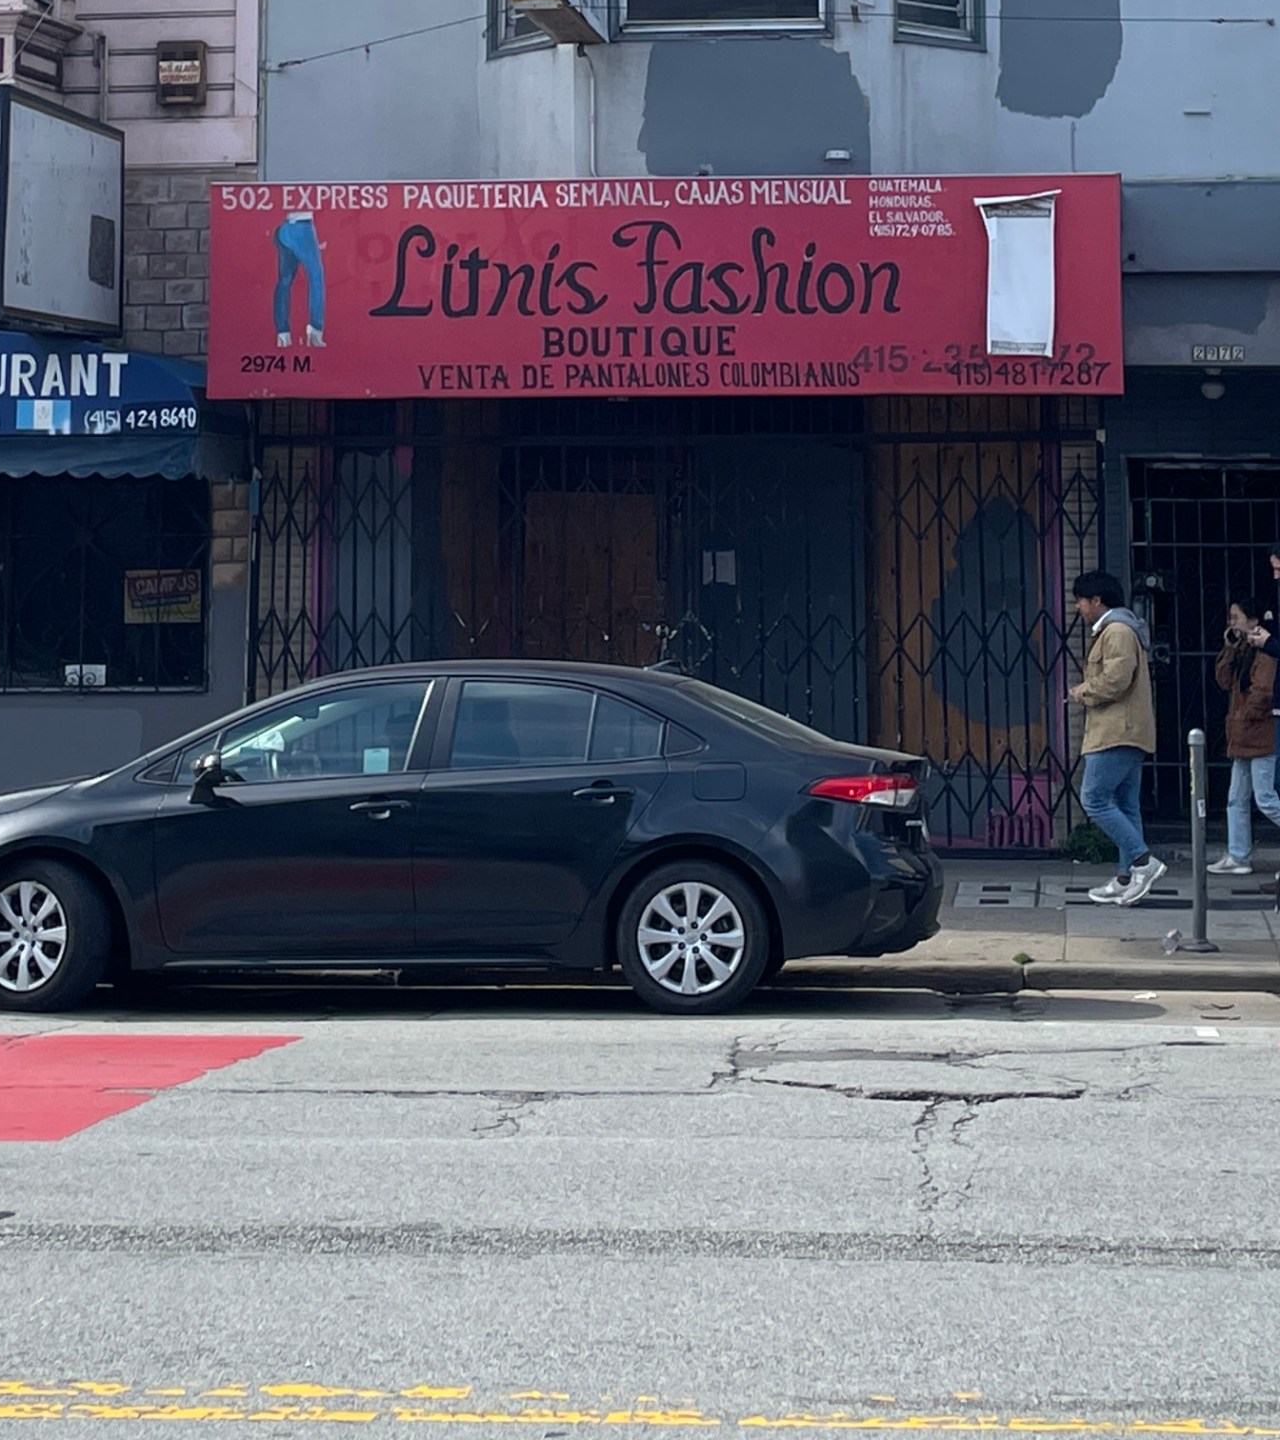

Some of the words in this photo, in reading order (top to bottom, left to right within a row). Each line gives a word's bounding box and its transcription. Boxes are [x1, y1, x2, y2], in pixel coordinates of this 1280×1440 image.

[222, 186, 273, 210] 502
[281, 185, 388, 209] EXPRESS
[403, 183, 549, 209] PAQUETERIA
[556, 181, 670, 208] SEMANAL,
[675, 180, 745, 205] CAJAS
[750, 179, 852, 205] MENSUAL
[869, 210, 883, 223] EL
[612, 220, 902, 316] Fashion
[542, 325, 737, 358] BOUTIQUE
[1193, 345, 1244, 361] 2972
[240, 356, 286, 373] 2974
[418, 364, 511, 390] VENTA
[522, 364, 554, 389] DE
[565, 363, 710, 389] PANTALONES
[720, 362, 860, 388] COLOMBIANOS
